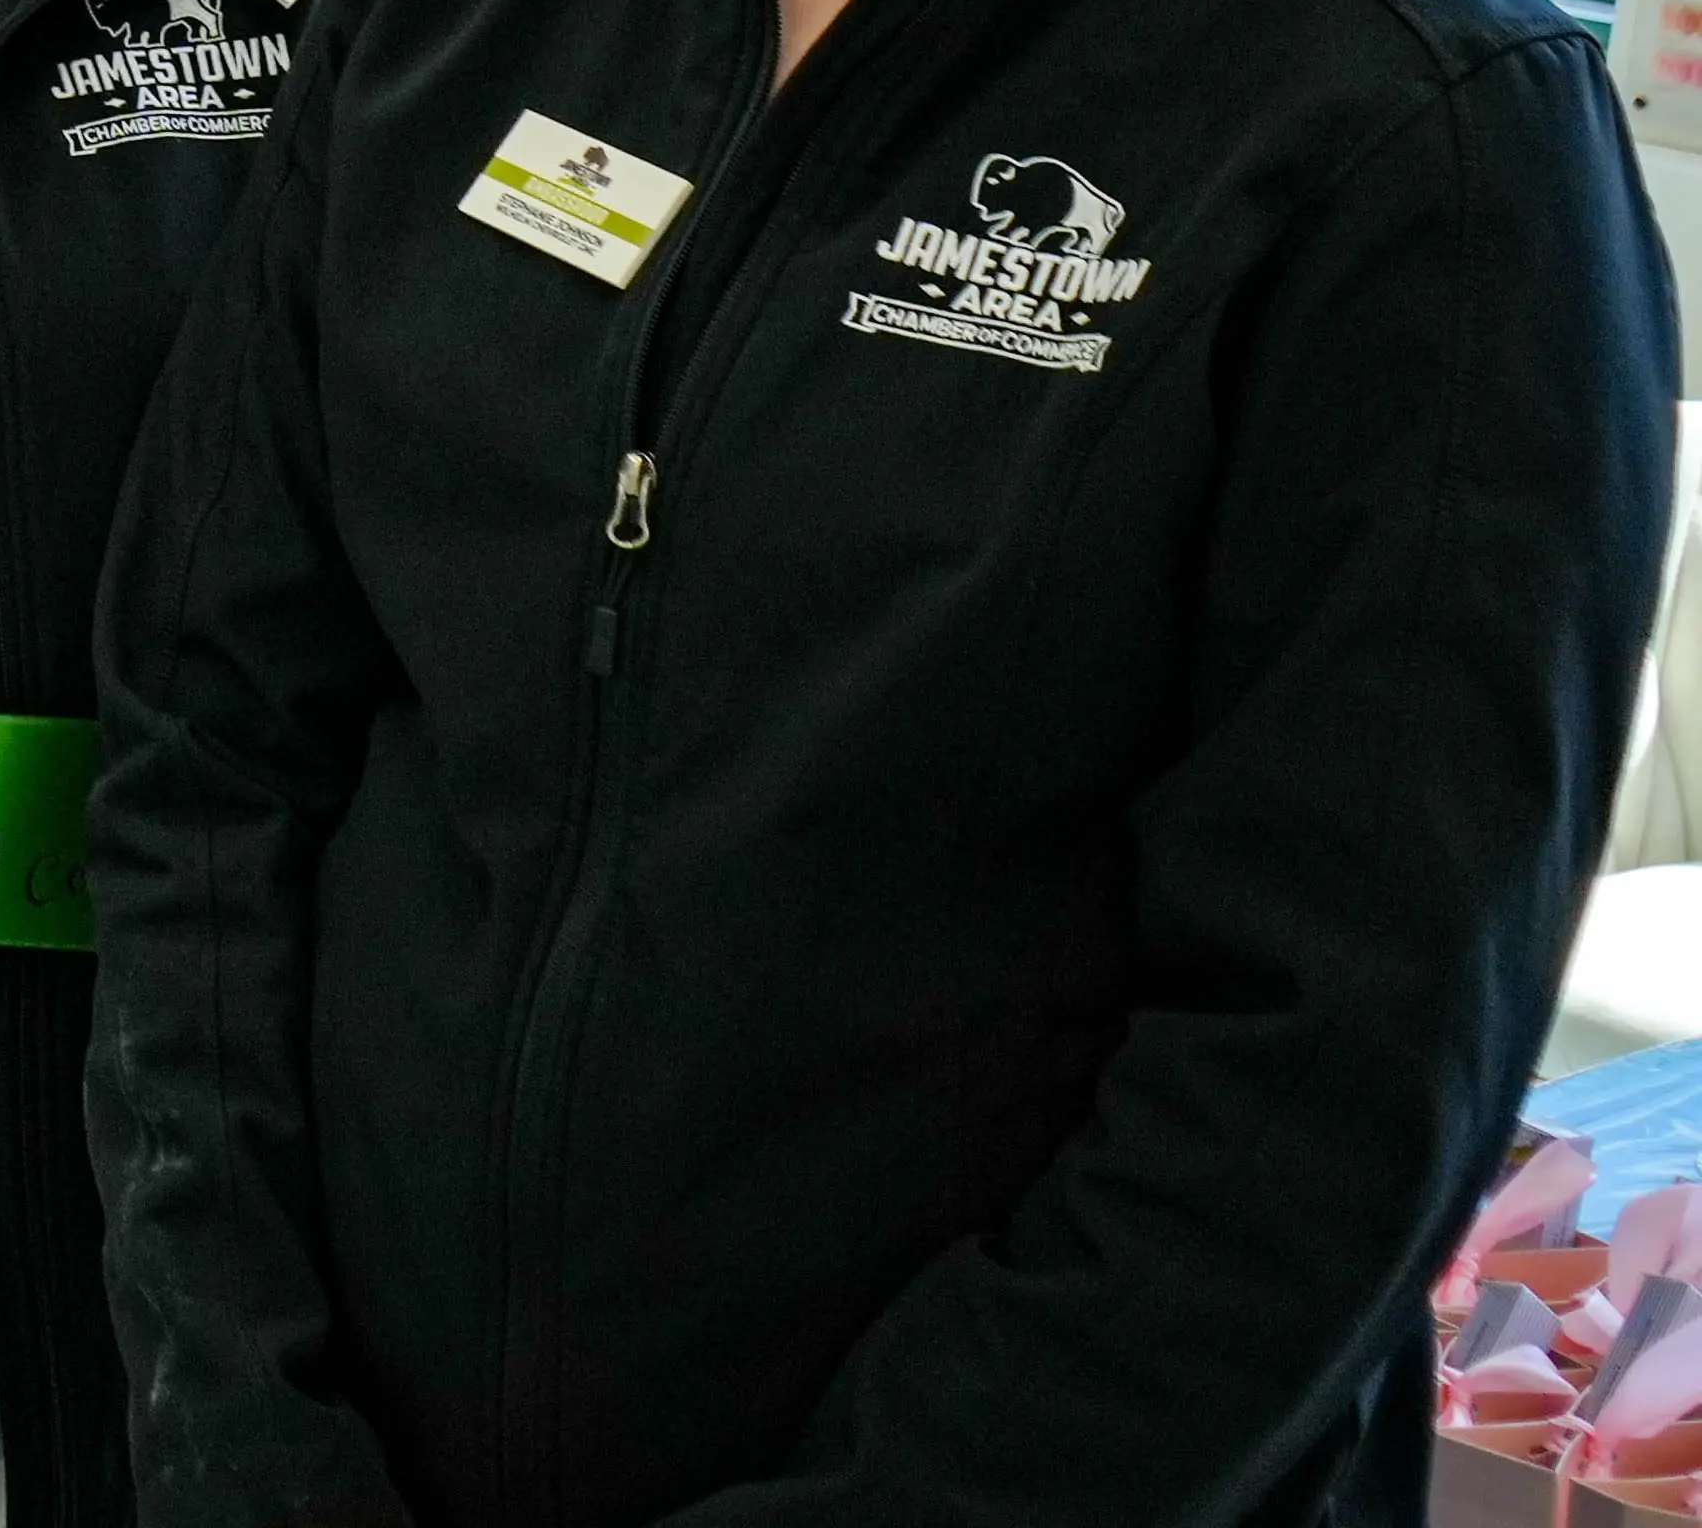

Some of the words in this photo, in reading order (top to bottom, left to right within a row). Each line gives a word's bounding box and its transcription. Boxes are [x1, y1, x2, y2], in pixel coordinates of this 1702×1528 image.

[51, 32, 292, 100] JAMESTOWN
[136, 84, 225, 110] AREA
[84, 115, 173, 144] CHAMBER
[876, 217, 1151, 304] JAMESTOWN
[872, 303, 977, 343] CHAMBER
[949, 283, 1063, 332] AREA
